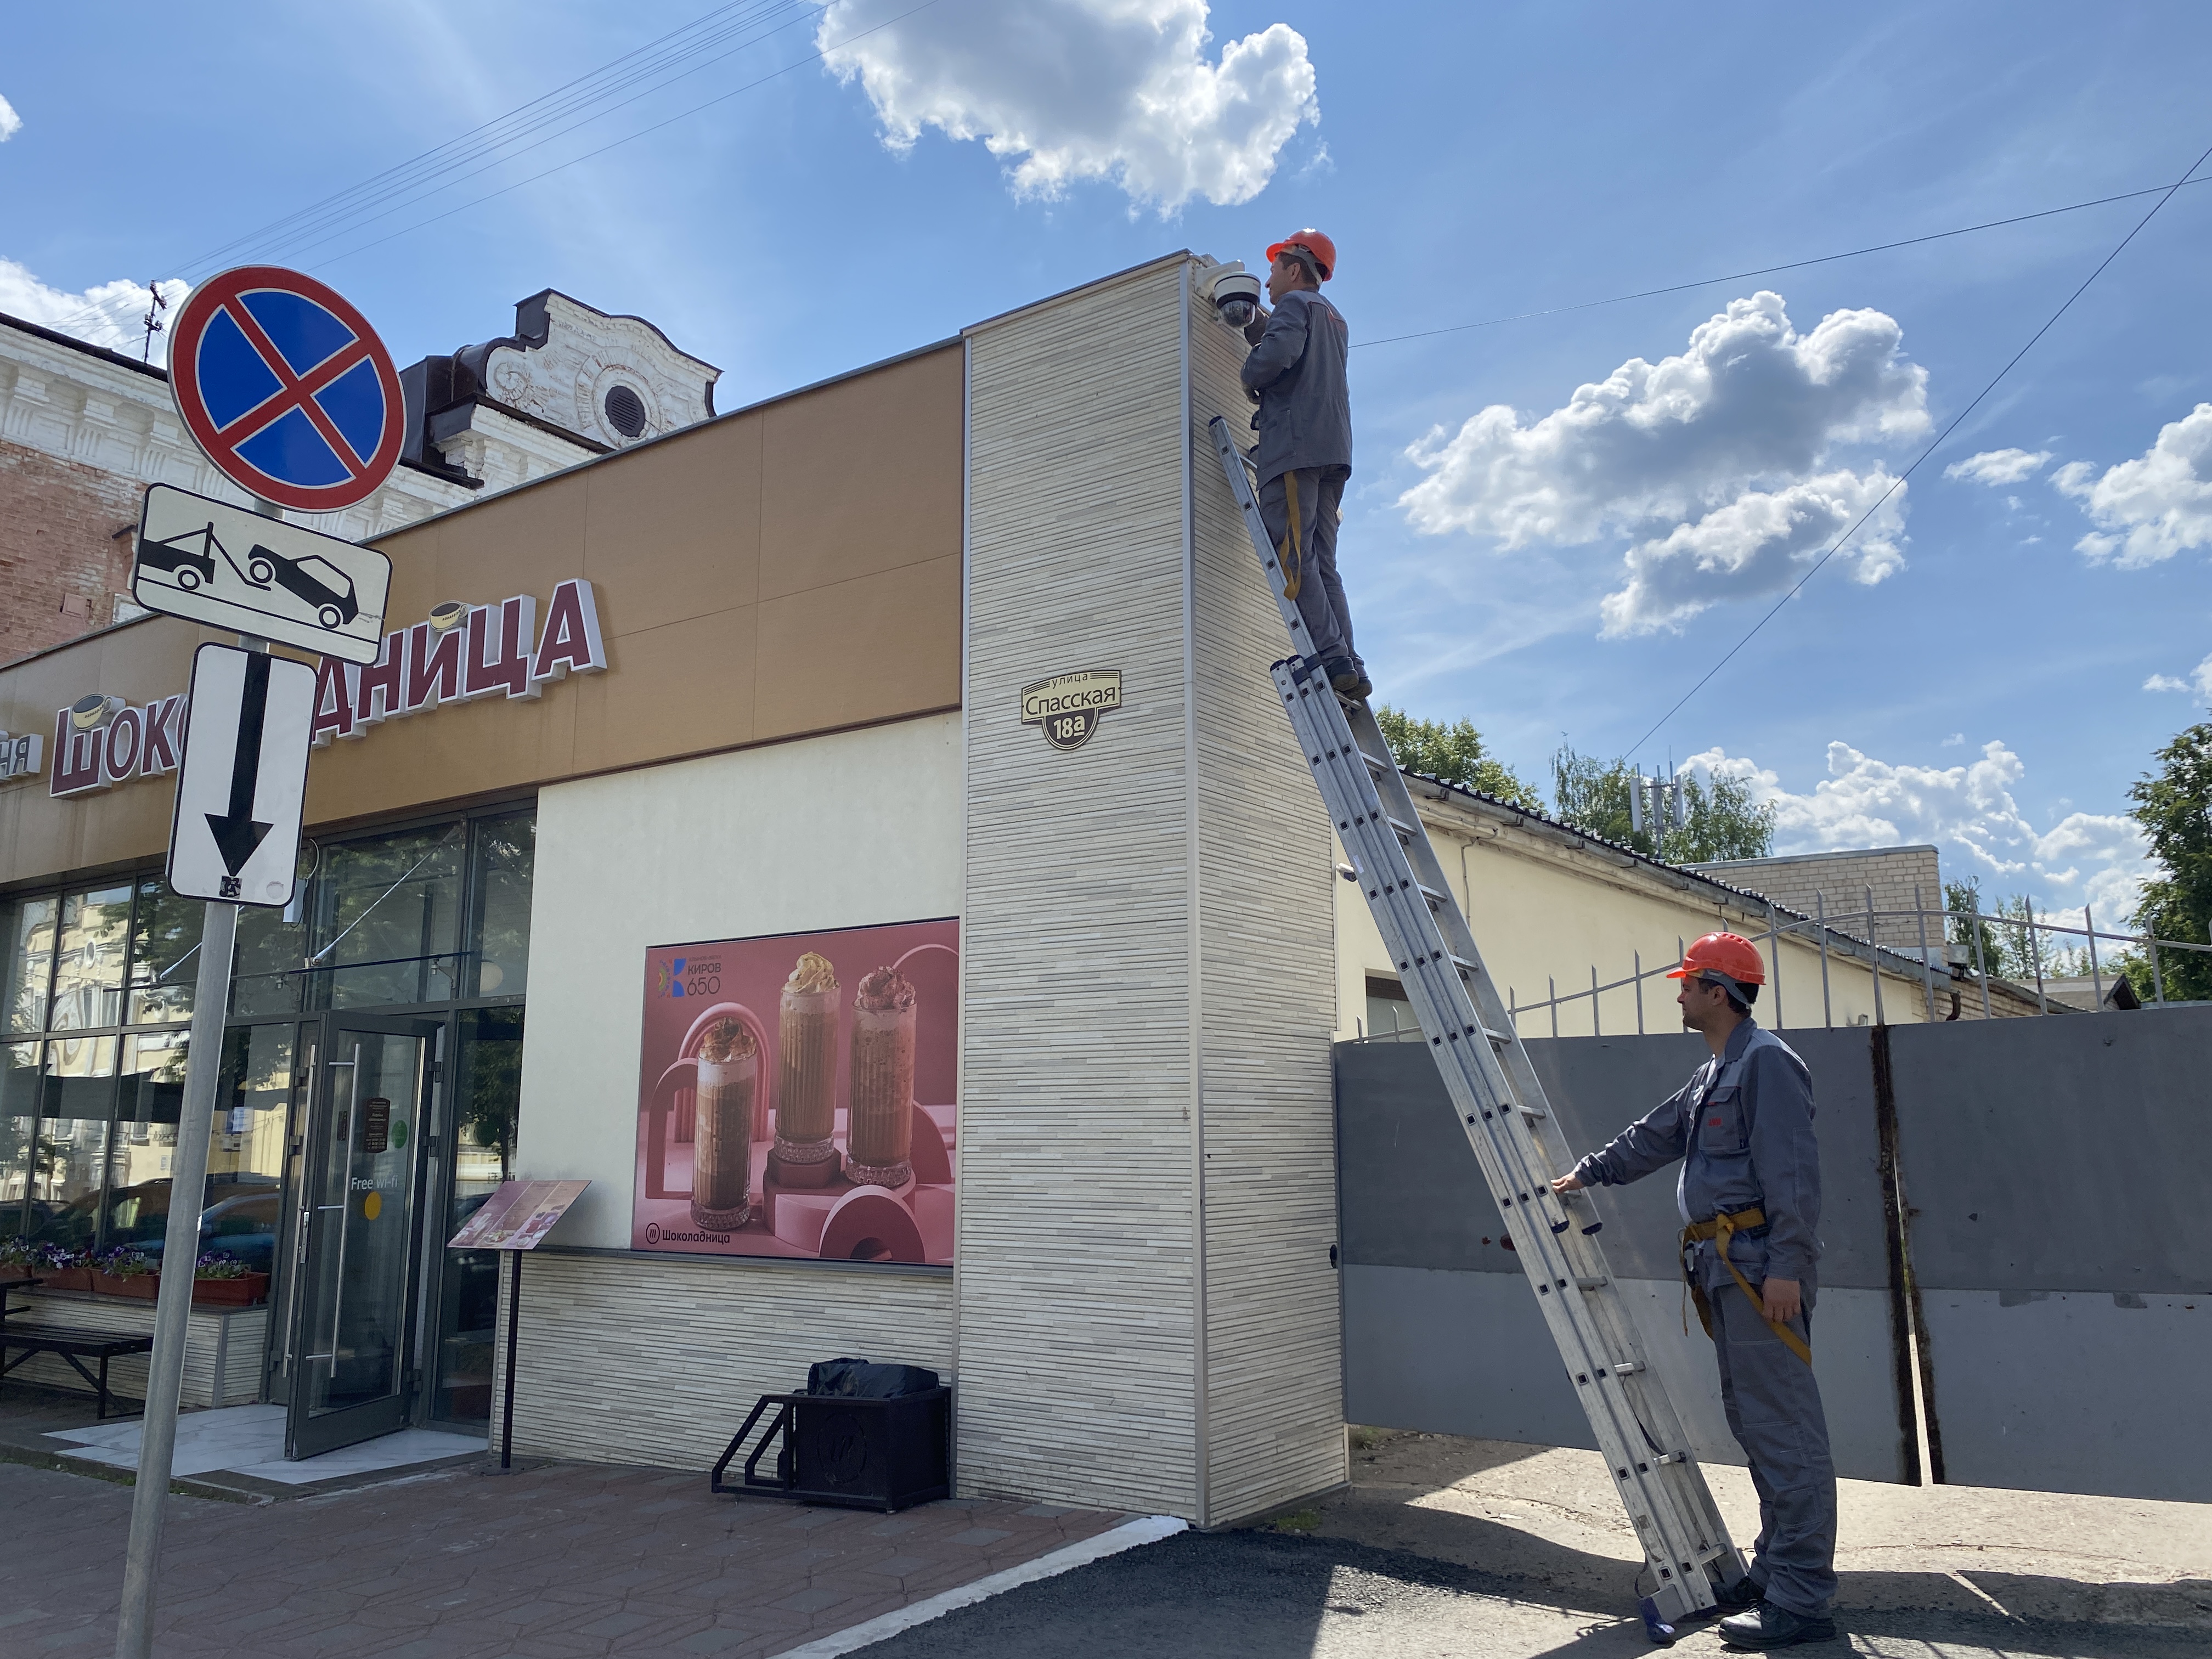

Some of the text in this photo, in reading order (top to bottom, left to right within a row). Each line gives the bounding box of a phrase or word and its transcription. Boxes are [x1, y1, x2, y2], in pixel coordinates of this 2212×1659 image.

[49, 578, 605, 798] ШОКДНИЦА
[1052, 673, 1088, 689] улица
[1025, 687, 1115, 715] Спасская
[1053, 715, 1085, 740] 18а
[688, 963, 721, 975] КИРОВ
[687, 976, 720, 996] 650
[351, 1175, 398, 1190] Free wi-fi
[662, 1229, 730, 1245] Шоколадница
